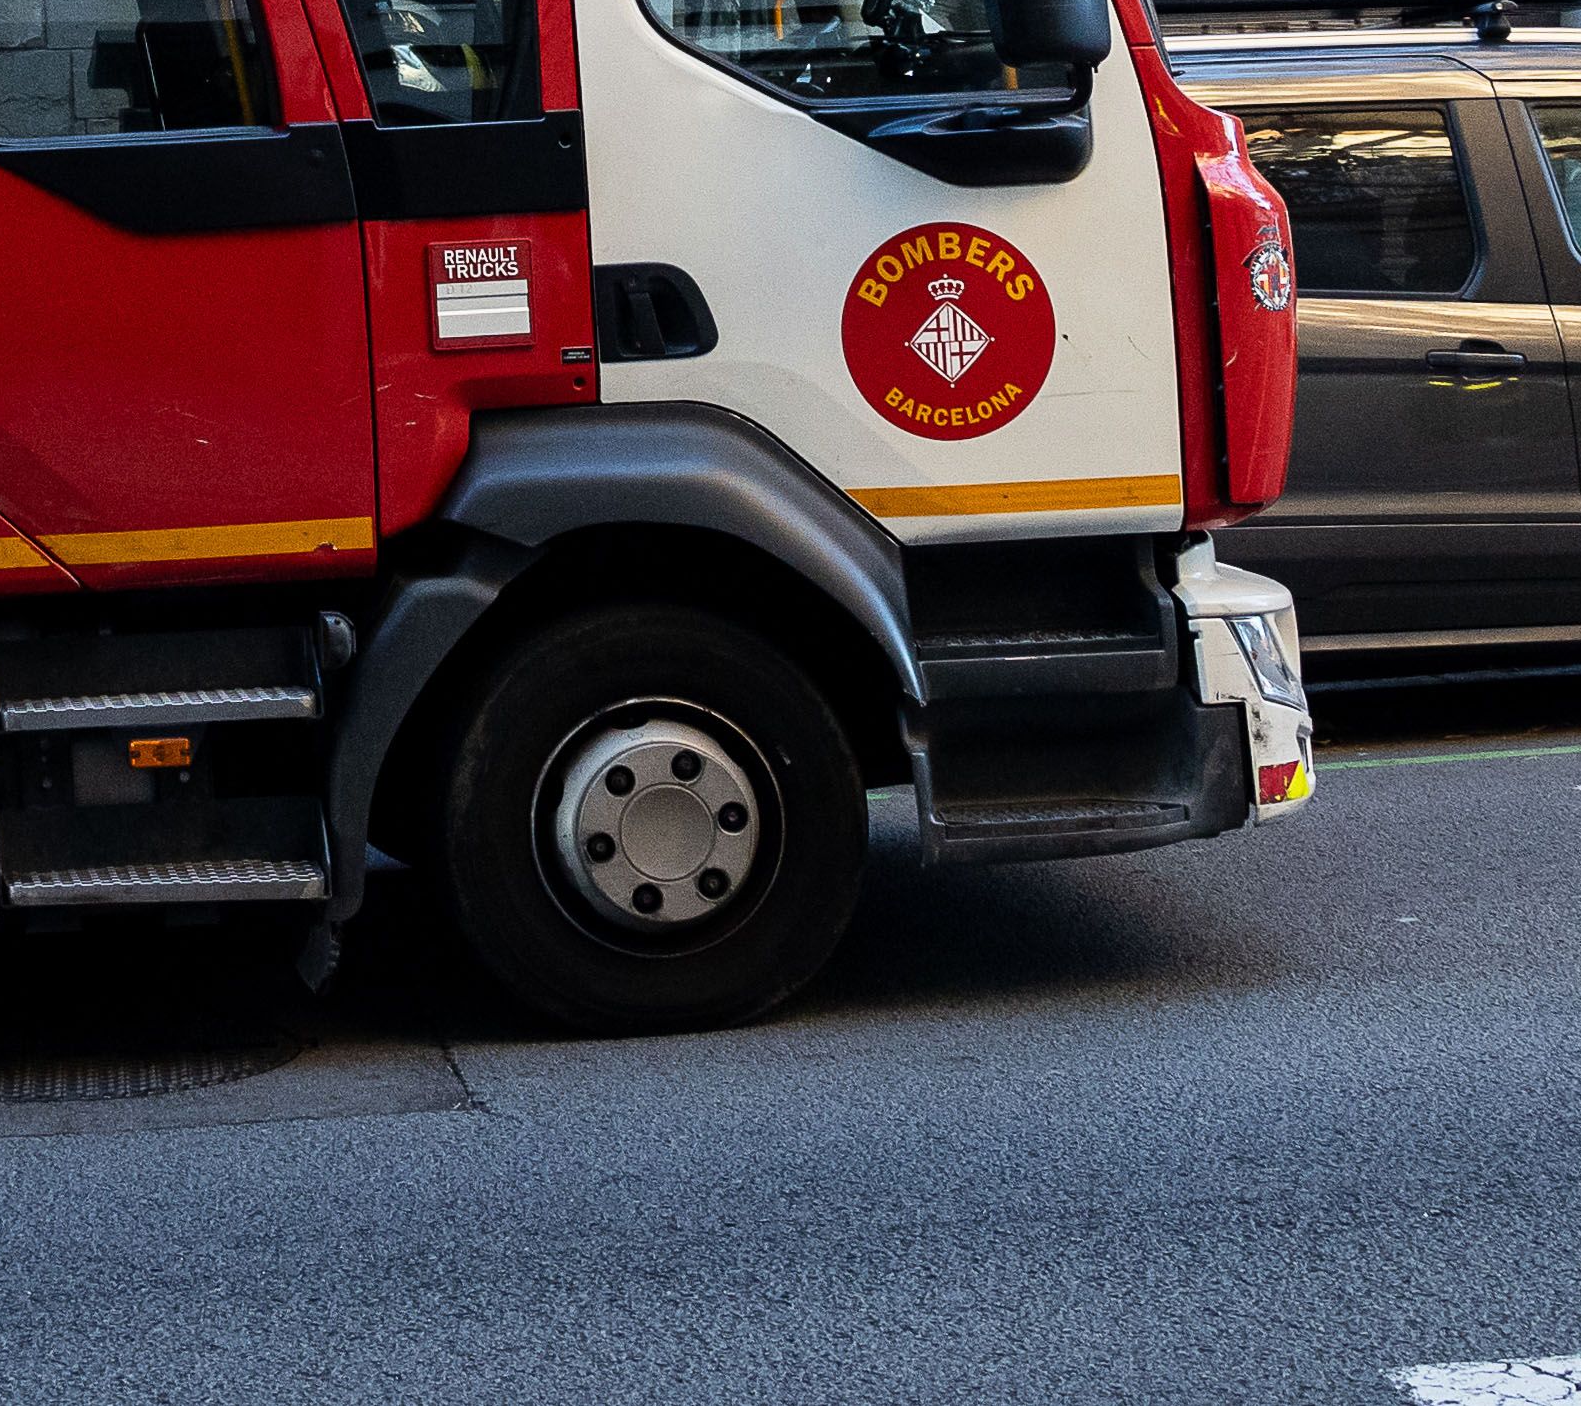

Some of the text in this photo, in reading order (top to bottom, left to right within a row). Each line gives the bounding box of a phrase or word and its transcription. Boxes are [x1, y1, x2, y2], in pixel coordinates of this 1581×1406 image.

[444, 246, 518, 265] RENAULT
[445, 261, 519, 279] TRUCKS
[857, 231, 1034, 308] BOMBERS
[884, 382, 1023, 427] BARCELONA
